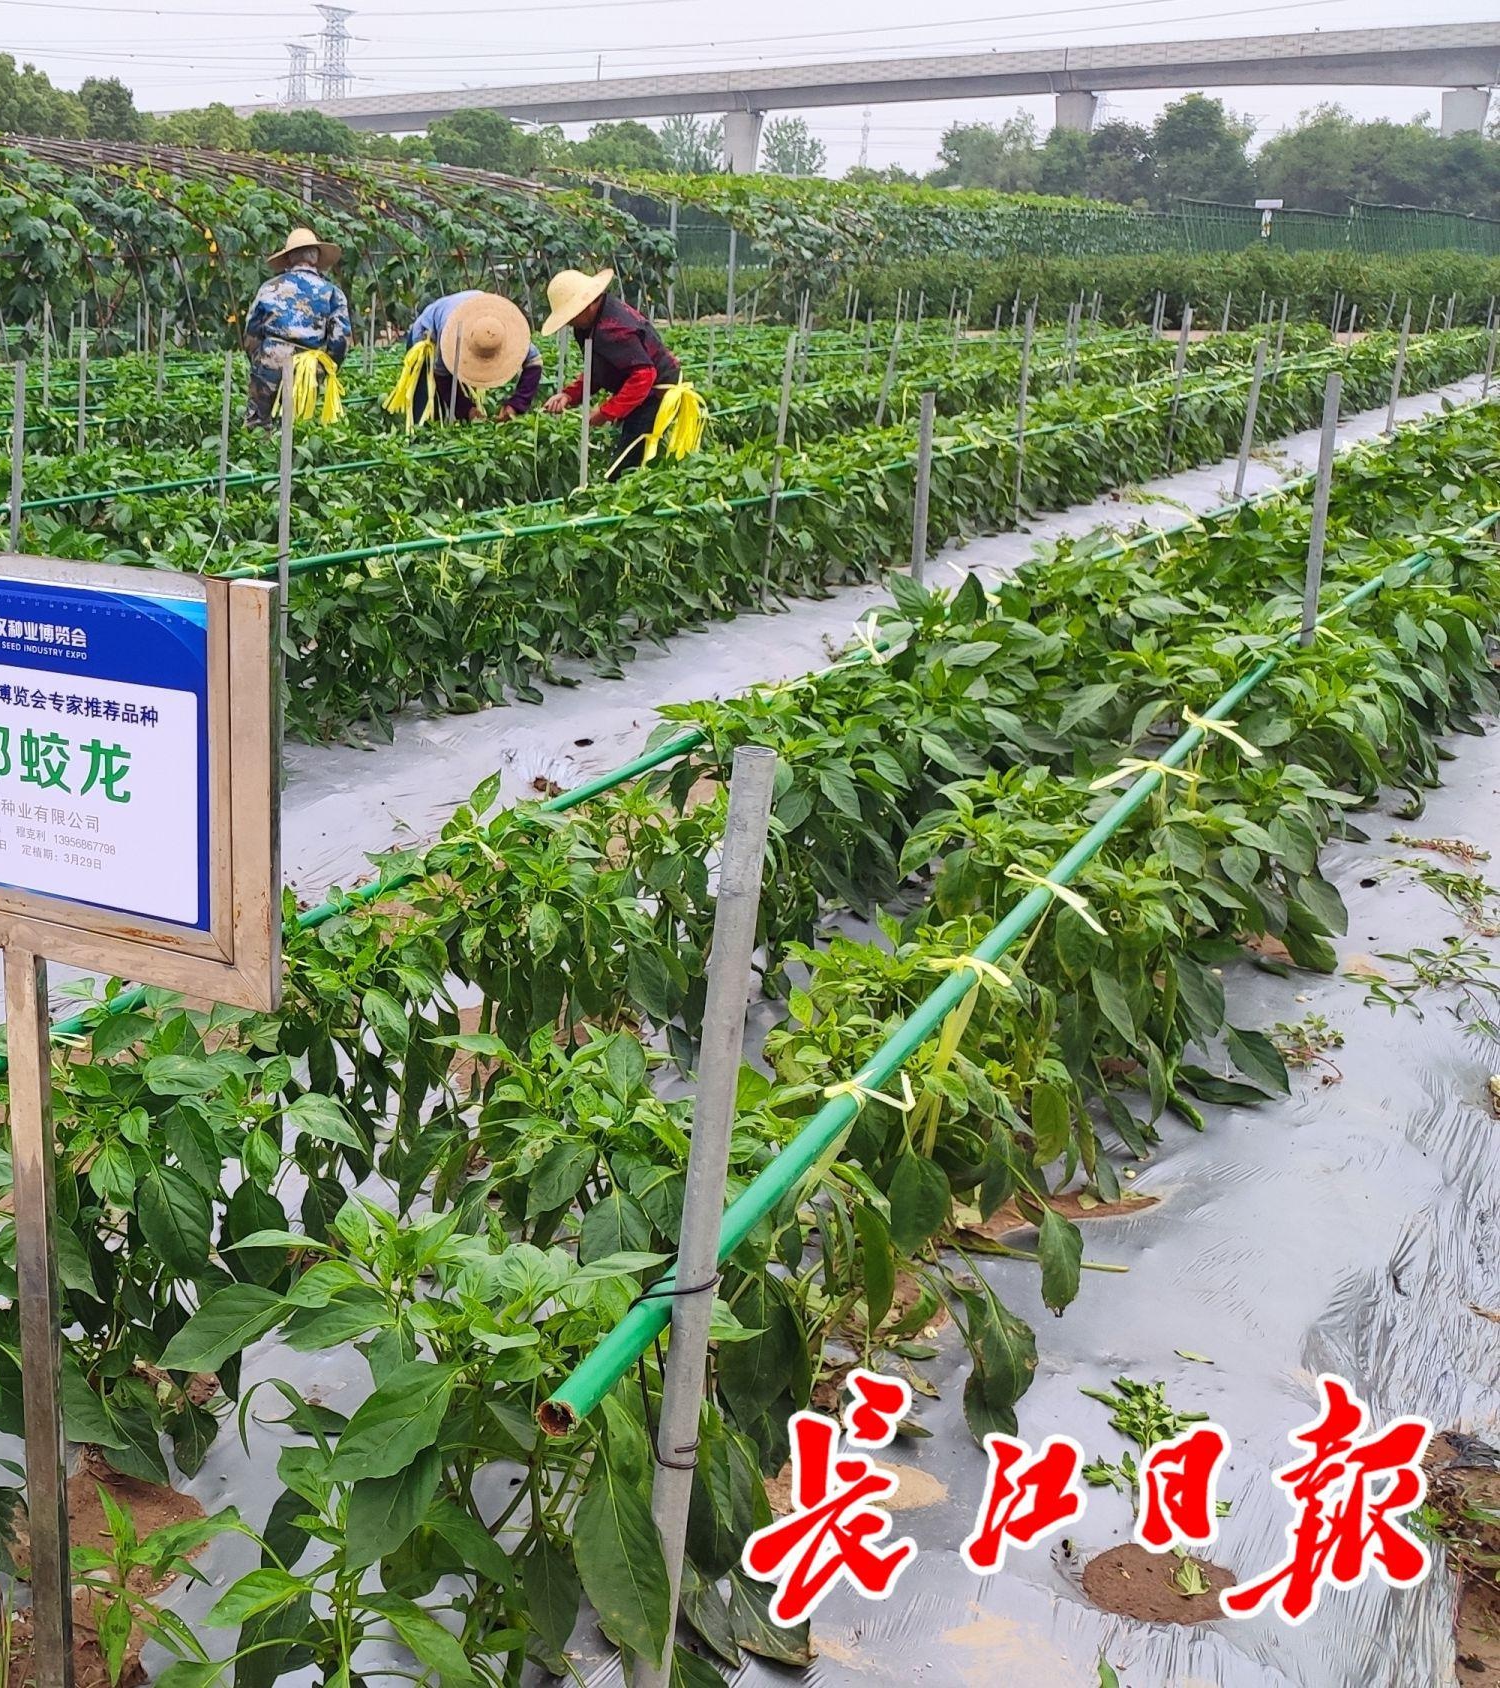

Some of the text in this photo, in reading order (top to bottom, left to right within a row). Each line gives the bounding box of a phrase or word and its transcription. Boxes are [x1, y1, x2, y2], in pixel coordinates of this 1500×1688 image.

[2, 641, 21, 651] SEED
[24, 644, 63, 658] INDUSTRY
[66, 649, 87, 660] EXPO
